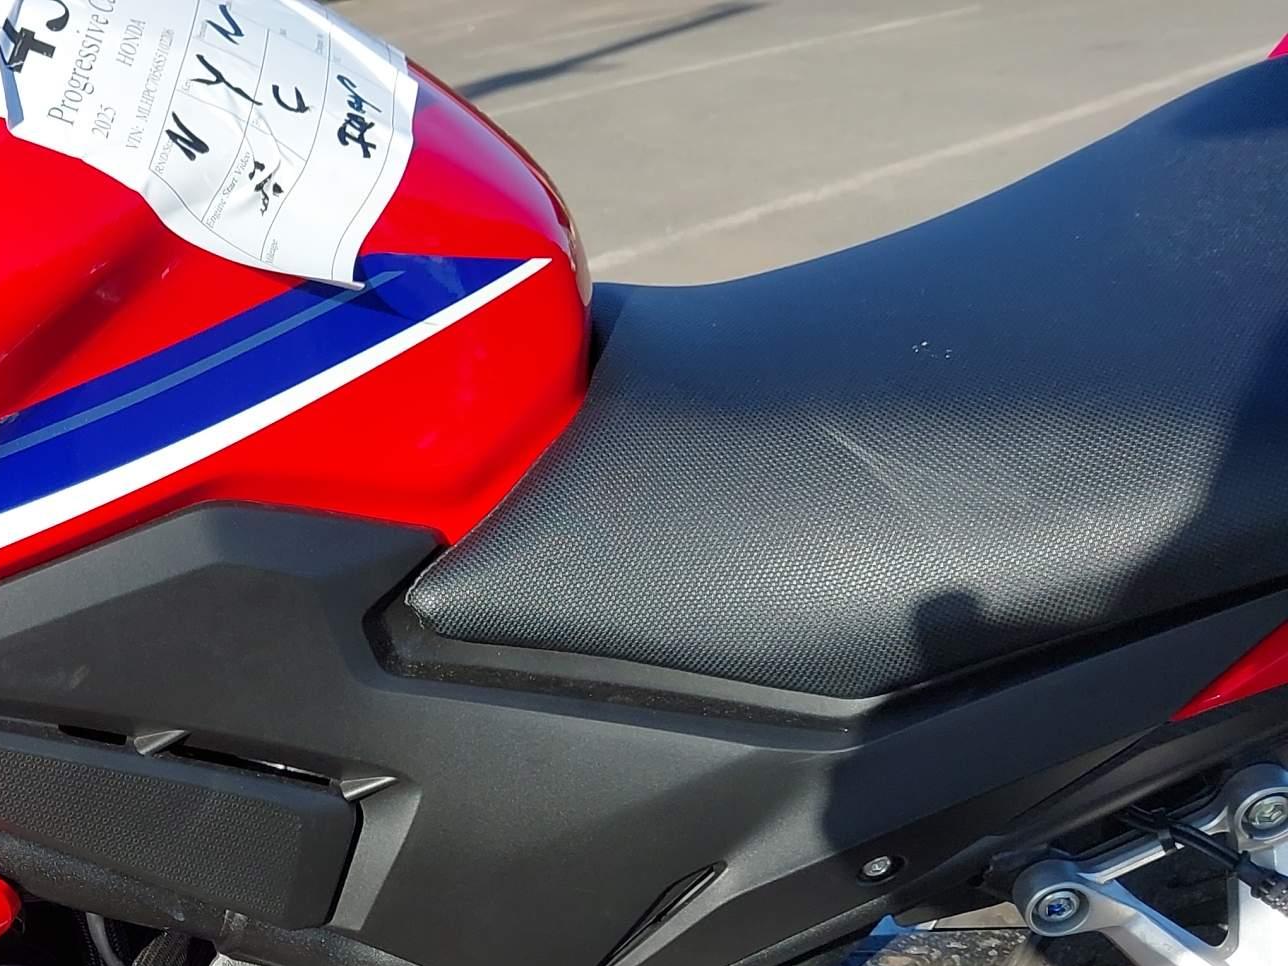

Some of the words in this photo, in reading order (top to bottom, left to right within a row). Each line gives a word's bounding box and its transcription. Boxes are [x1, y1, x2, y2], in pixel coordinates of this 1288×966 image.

[116, 18, 146, 67] HONDA
[206, 5, 244, 45] N
[47, 13, 110, 126] Progressive
[190, 54, 263, 106] Y
[91, 104, 116, 139] 2025
[125, 128, 144, 150] VIN:
[165, 112, 209, 161] N
[205, 197, 229, 230] Engine
[222, 174, 238, 199] Start
